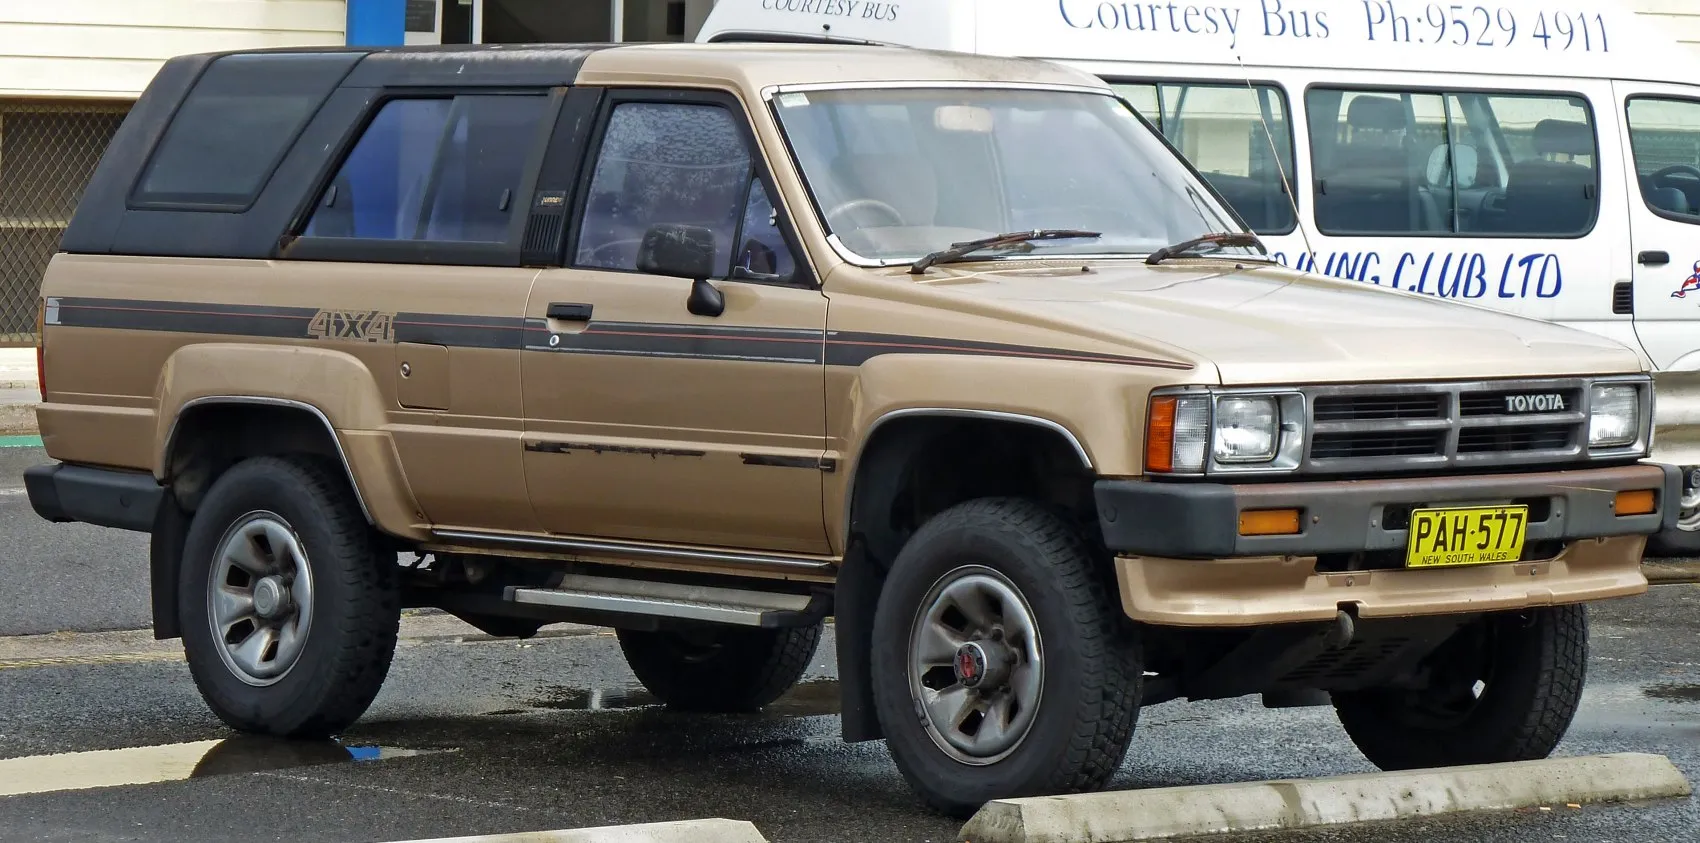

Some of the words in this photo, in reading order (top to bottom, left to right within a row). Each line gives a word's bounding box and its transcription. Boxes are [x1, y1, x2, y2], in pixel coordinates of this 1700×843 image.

[762, 0, 859, 17] COURTESY
[862, 3, 900, 21] BUS
[1059, 0, 1240, 49] Courtesy
[1260, 0, 1330, 39] Bus
[1361, 0, 1516, 48] Ph:9529
[1532, 10, 1609, 52] 4911
[1392, 252, 1487, 298] CLUB
[1498, 253, 1563, 298] LTD
[1505, 394, 1564, 411] TOYOTA
[1421, 555, 1442, 565] NEW
[1445, 553, 1475, 563] SOUTH
[1480, 551, 1508, 561] WALES
